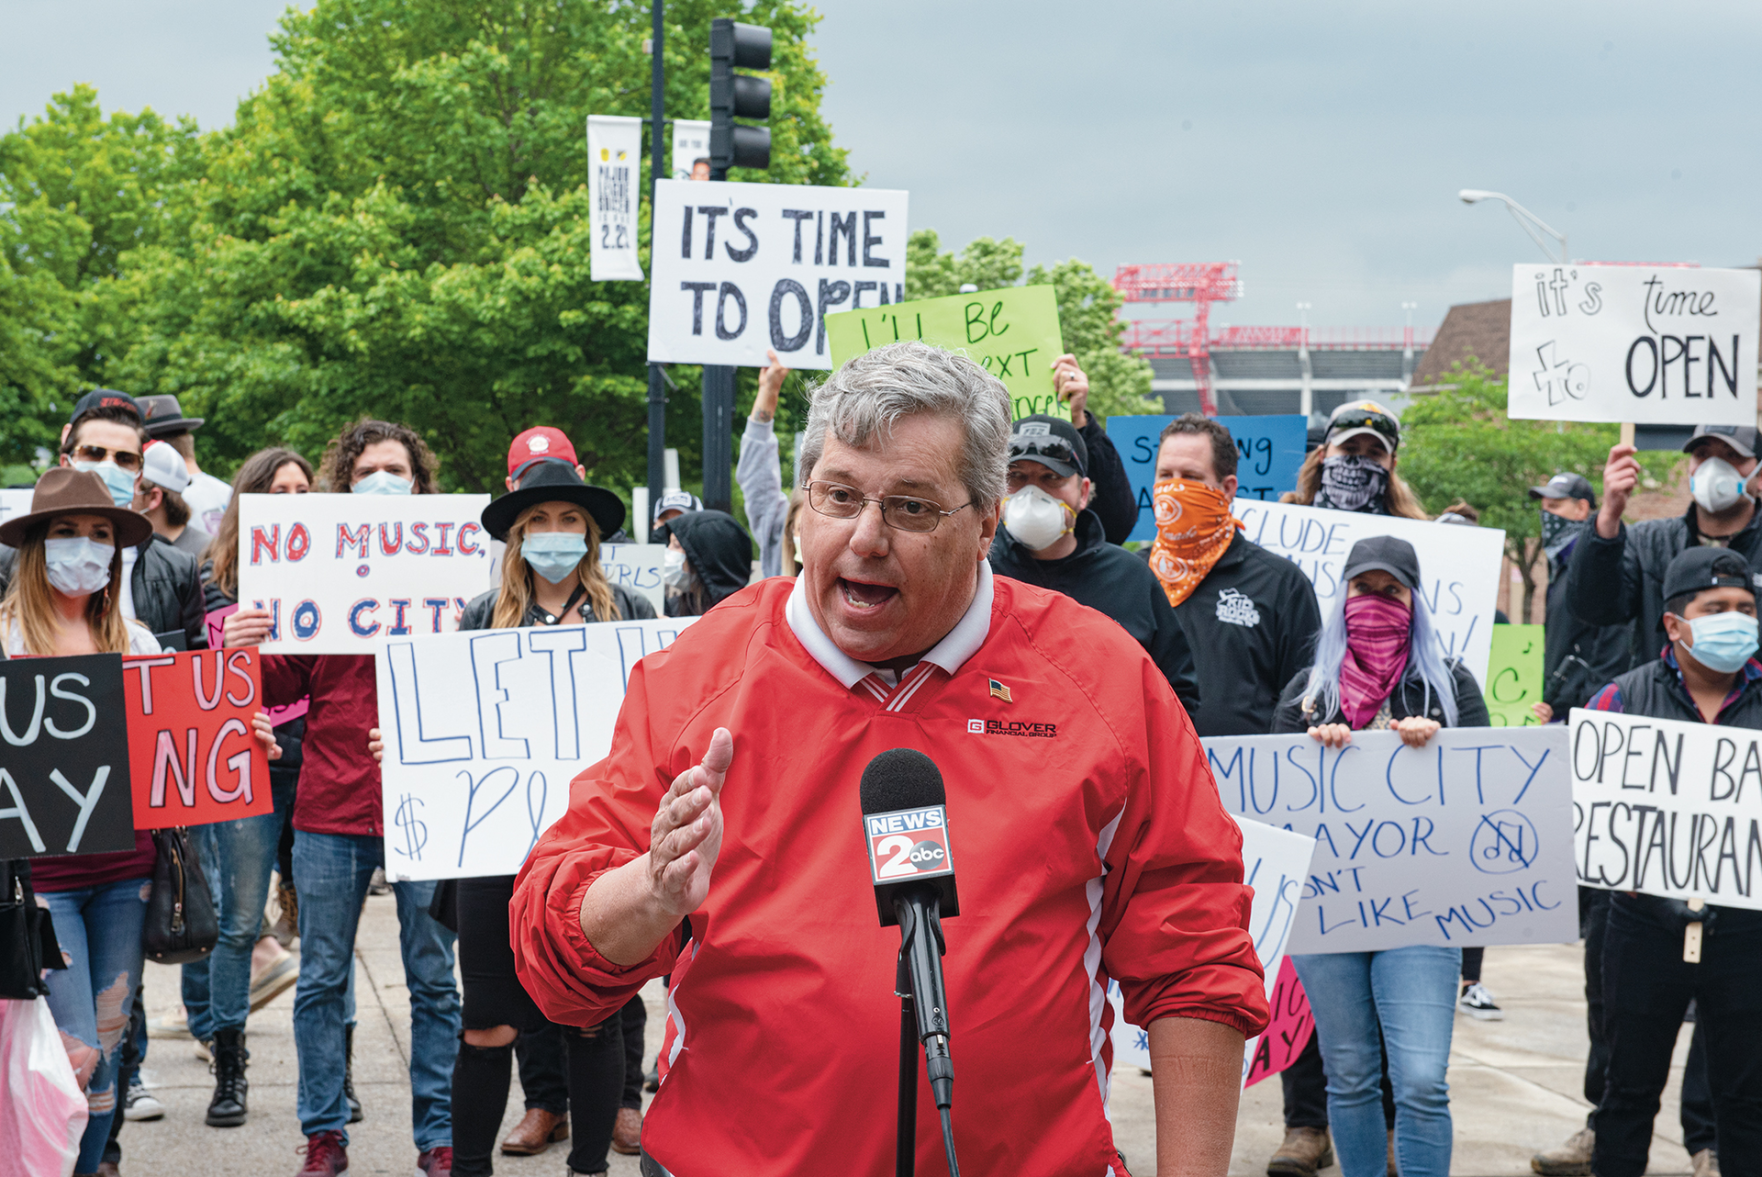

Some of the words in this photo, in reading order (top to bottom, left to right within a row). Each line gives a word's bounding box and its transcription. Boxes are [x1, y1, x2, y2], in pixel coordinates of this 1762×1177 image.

[681, 197, 759, 263] IT'S
[782, 209, 890, 268] TIME
[681, 280, 748, 341] TO
[1534, 268, 1603, 318] it's
[1643, 274, 1719, 335] time
[1625, 334, 1740, 399] OPEN
[250, 522, 312, 566] NO
[336, 520, 487, 561] MUSIC,
[192, 650, 257, 712] US
[387, 627, 587, 766] LET
[986, 720, 1057, 733] GLOVER
[1386, 743, 1551, 806] CITY
[1573, 719, 1685, 796] OPEN
[870, 811, 942, 835] NEWS
[1271, 816, 1450, 861] AYOR
[876, 834, 918, 878] 2
[908, 846, 945, 862] abc
[1318, 889, 1433, 935] LIKE
[1435, 880, 1562, 941] MUSIC
